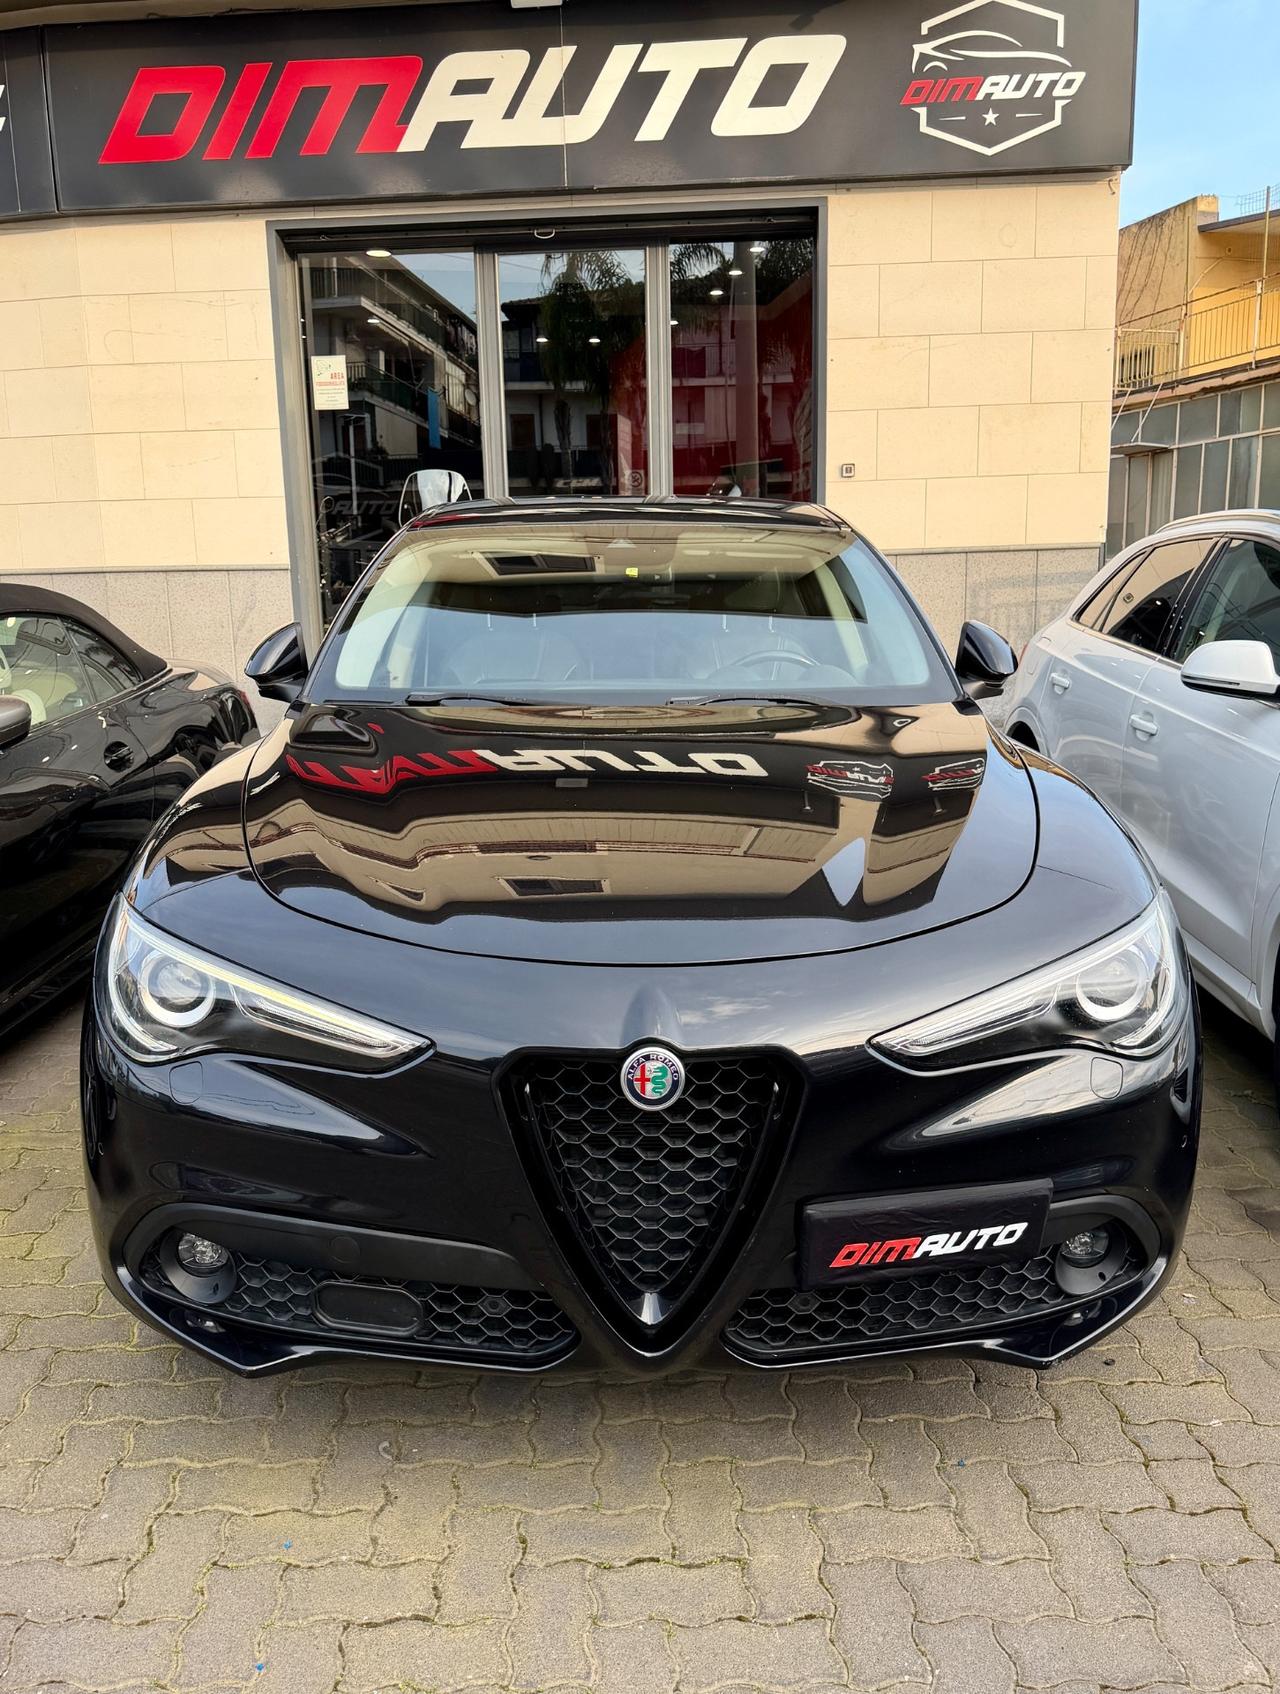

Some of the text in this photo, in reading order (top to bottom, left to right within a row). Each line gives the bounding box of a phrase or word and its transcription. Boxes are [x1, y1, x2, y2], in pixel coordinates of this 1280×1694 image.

[98, 34, 847, 164] DIMAUTO
[900, 71, 1086, 105] DIMAUTO
[628, 1054, 679, 1081] ALFA ROMEO
[828, 1221, 1029, 1268] DIMAUTO
